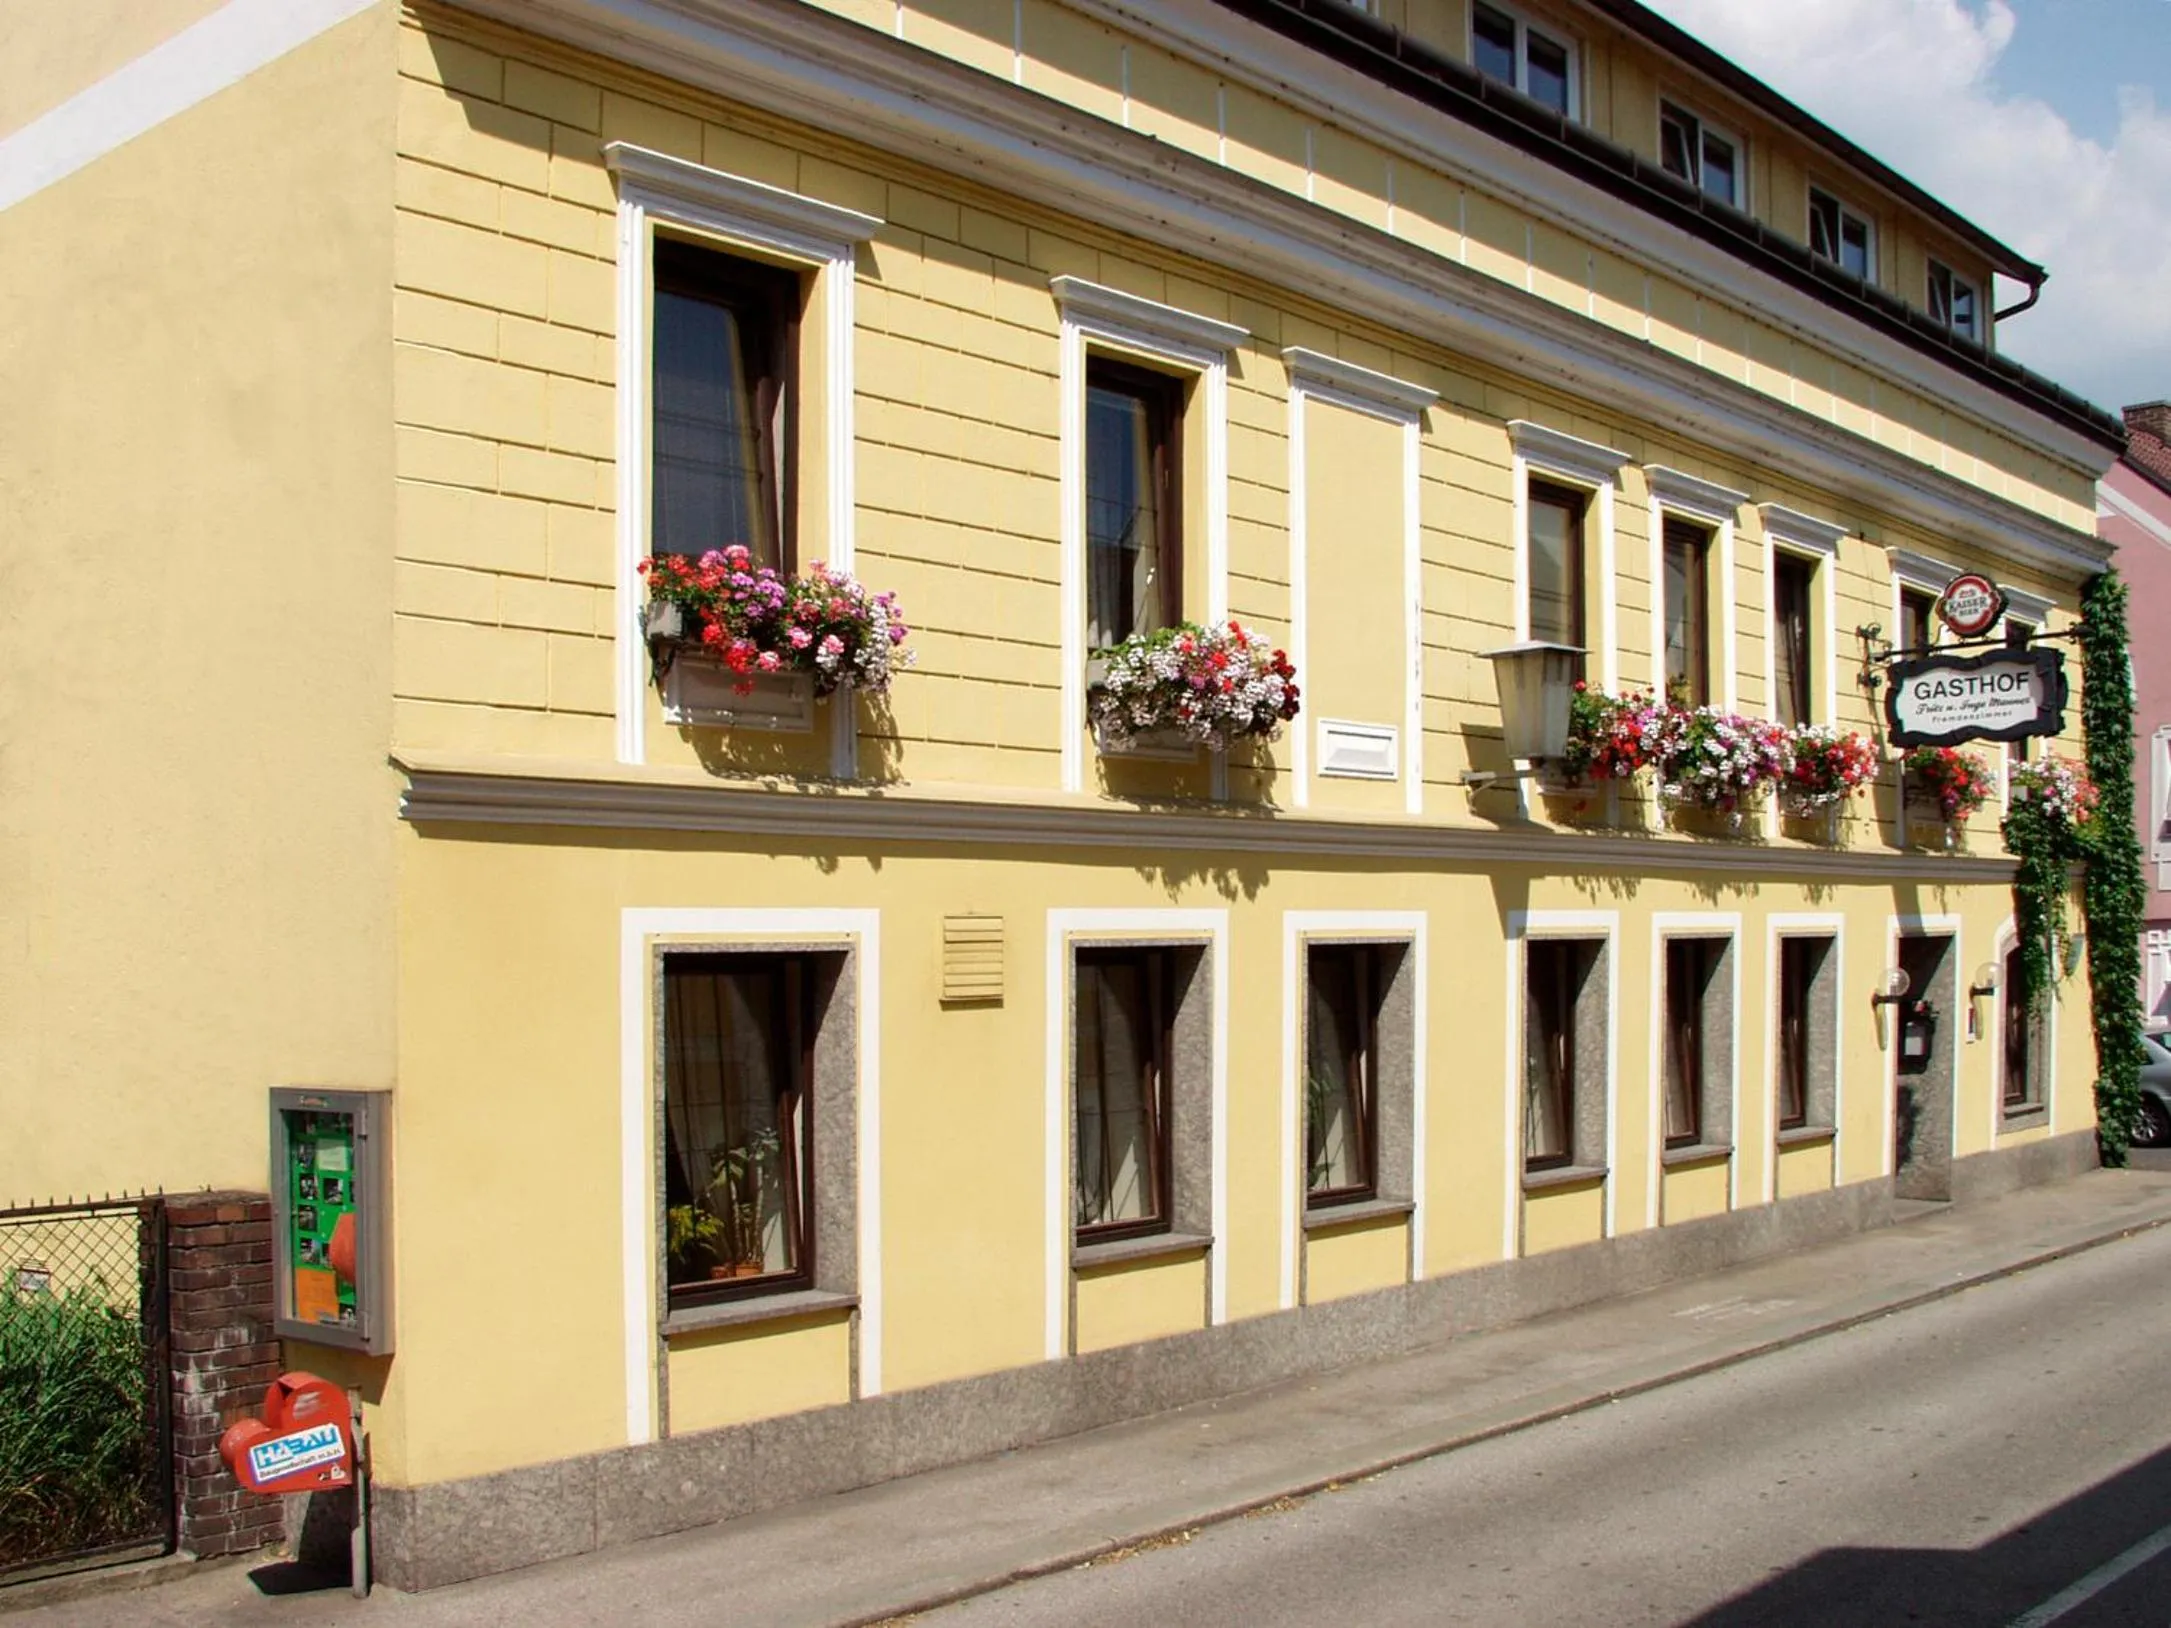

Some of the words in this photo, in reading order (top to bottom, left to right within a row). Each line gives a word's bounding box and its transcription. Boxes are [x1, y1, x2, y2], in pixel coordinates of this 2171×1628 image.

[1949, 596, 1988, 614] KAISER
[1914, 672, 2029, 700] GASTHOF
[254, 1427, 338, 1469] HABAU
